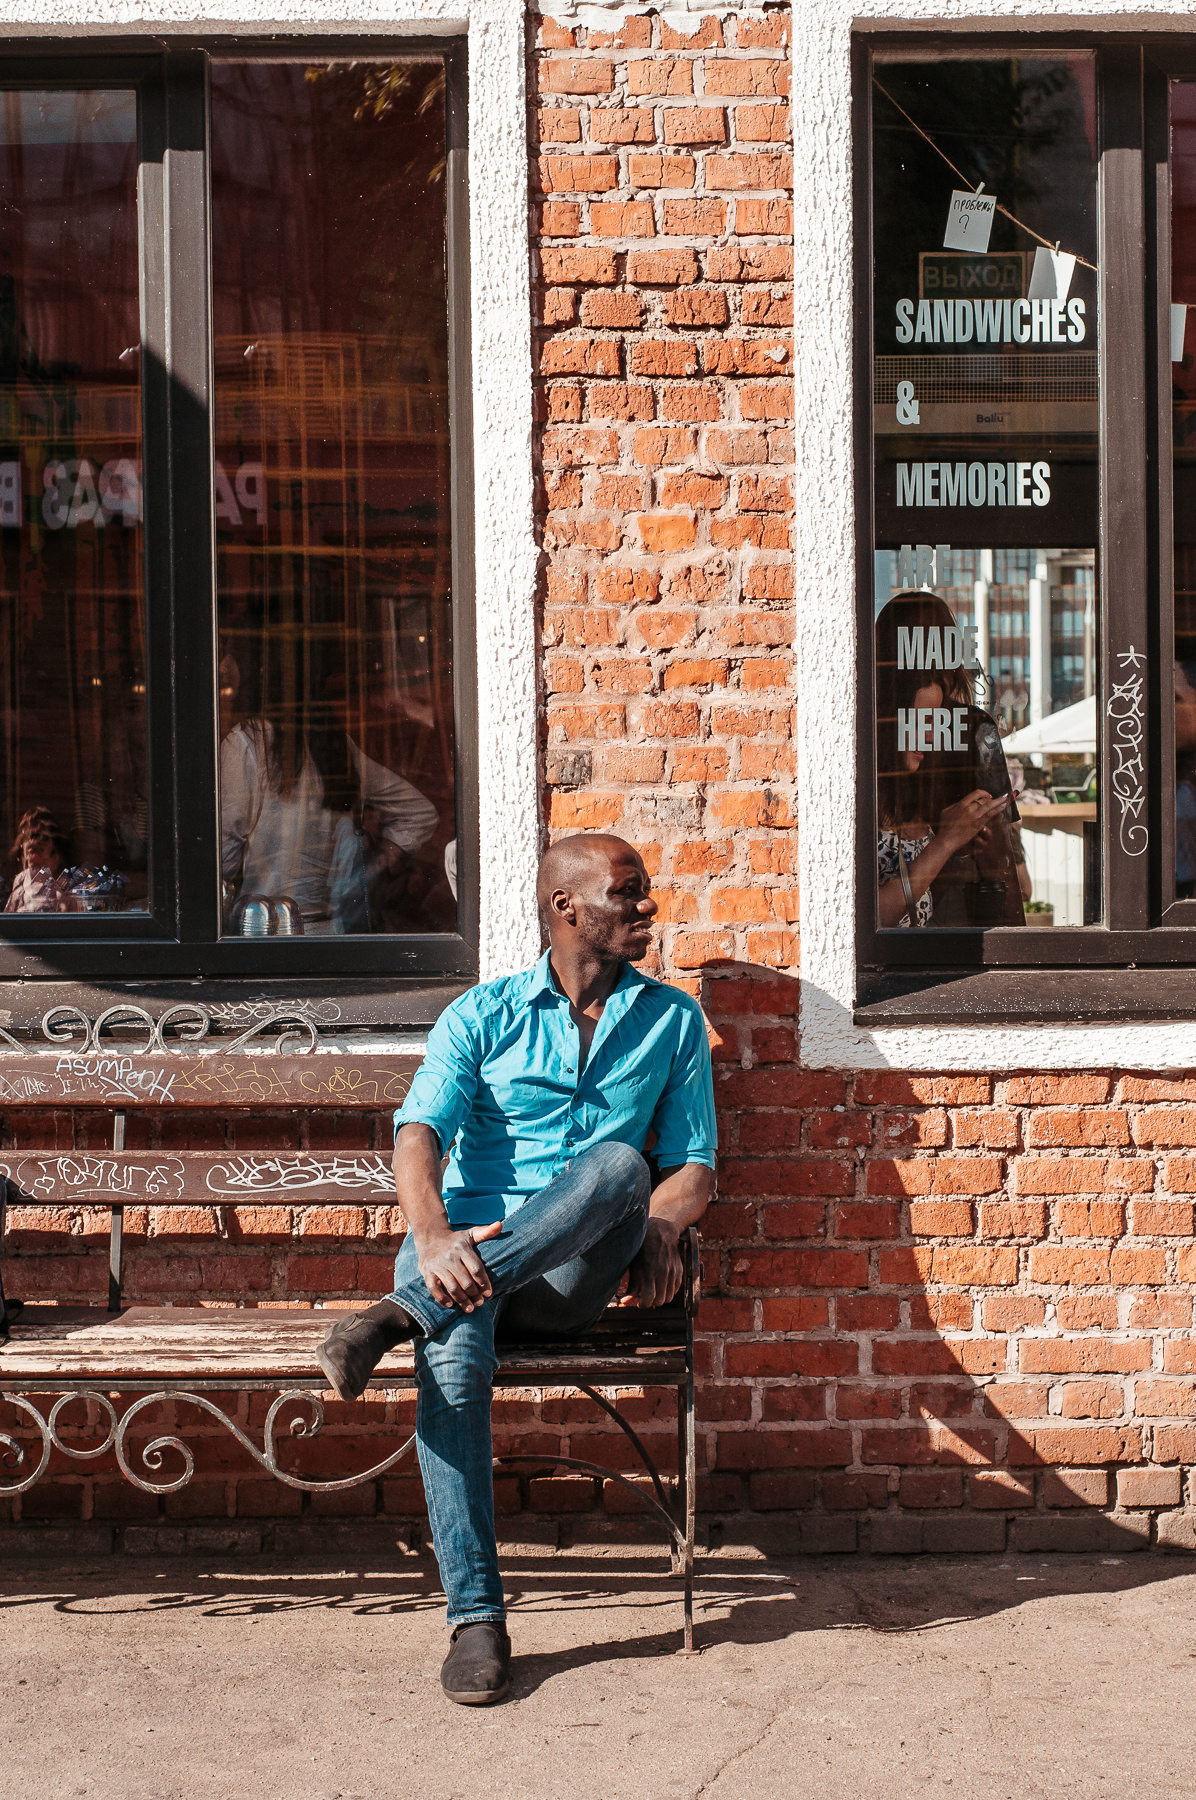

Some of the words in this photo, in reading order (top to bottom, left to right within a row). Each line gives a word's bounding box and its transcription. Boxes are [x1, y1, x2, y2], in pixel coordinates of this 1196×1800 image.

[924, 264, 1018, 291] ВЫХОД
[895, 298, 1086, 343] SANDWICHES
[896, 380, 920, 425] &
[896, 461, 1051, 507] MEMORIES
[899, 544, 952, 588] ARE
[897, 626, 979, 670] MADE
[897, 708, 969, 752] HERE
